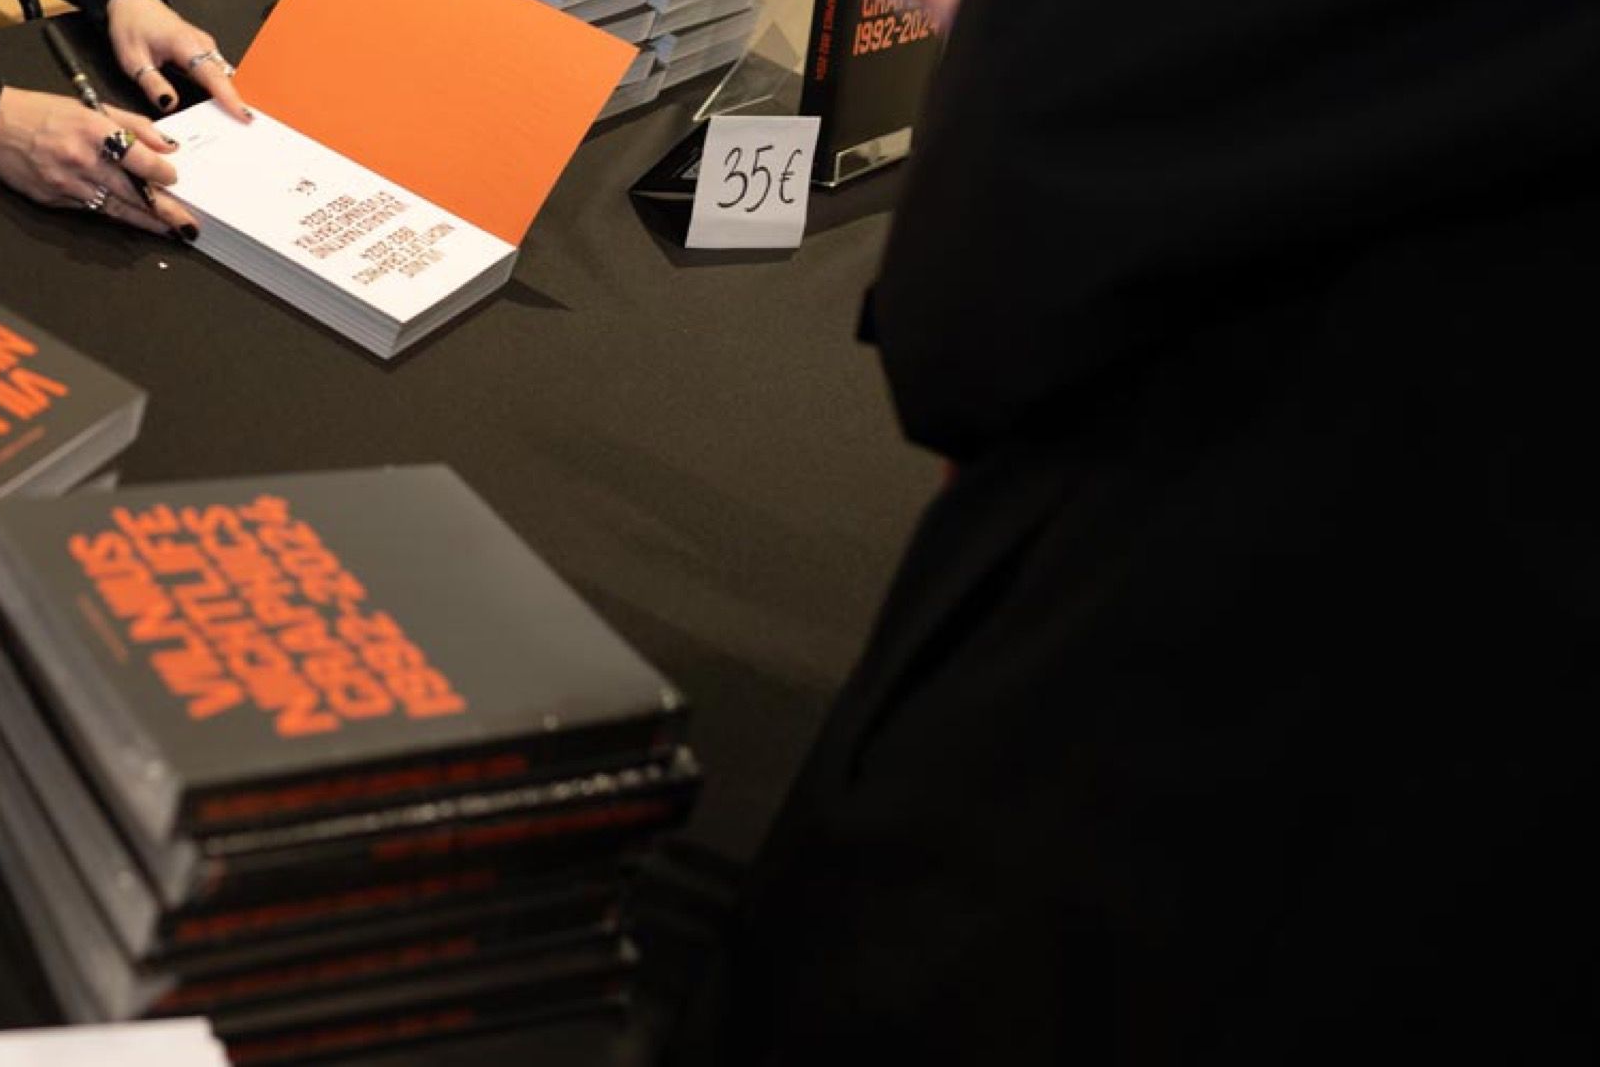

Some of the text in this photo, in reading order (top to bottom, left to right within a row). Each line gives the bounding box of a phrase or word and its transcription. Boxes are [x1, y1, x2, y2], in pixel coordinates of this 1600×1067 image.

[716, 144, 802, 213] 35€
[67, 531, 246, 720] VILNIUS
[237, 493, 469, 720] 1992-2024
